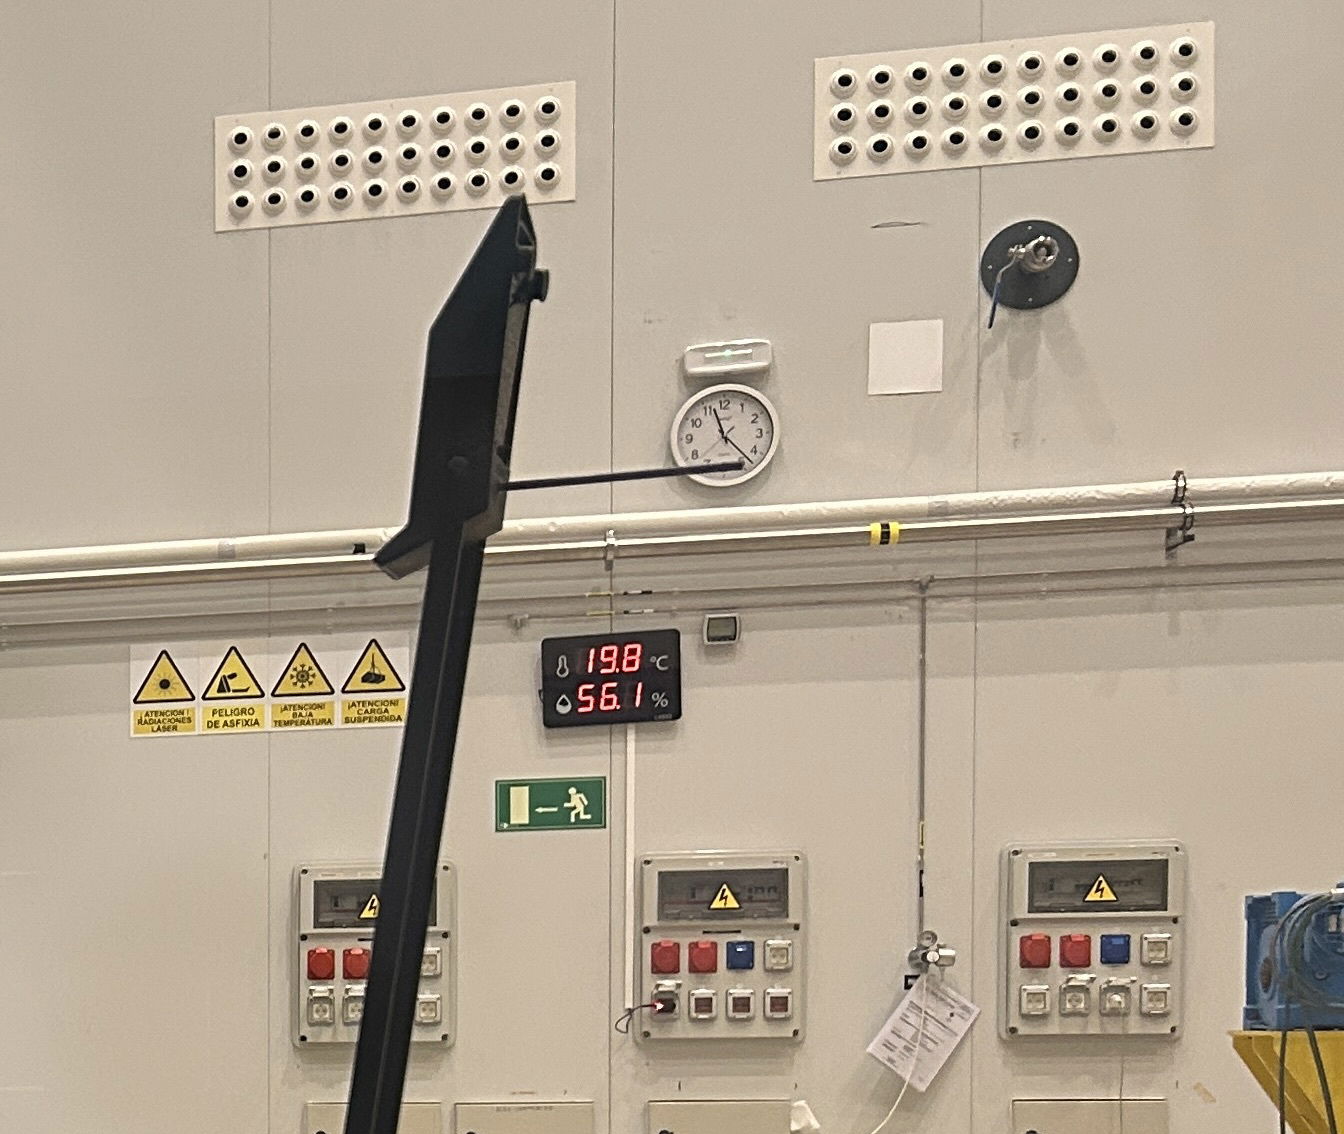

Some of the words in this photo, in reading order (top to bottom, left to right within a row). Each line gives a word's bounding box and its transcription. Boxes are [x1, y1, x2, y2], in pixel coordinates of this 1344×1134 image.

[719, 399, 731, 410] 12
[691, 418, 702, 429] 10
[750, 413, 759, 424] 2
[685, 433, 693, 444] 9
[756, 428, 763, 439] 3
[691, 449, 699, 460] 8
[750, 445, 758, 455] 4
[587, 643, 642, 674] 19.8
[577, 682, 643, 713] 56.1
[211, 707, 255, 718] PELIGRO
[292, 711, 314, 719] BAJA
[356, 707, 390, 716] CARGA
[137, 716, 192, 726] RADIACIONES
[206, 719, 220, 729] DE
[222, 718, 260, 729] ASFIXIA
[273, 718, 333, 728] TEMPERATURA
[344, 714, 403, 724] SUSPENDIDA
[150, 724, 178, 733] LASER
